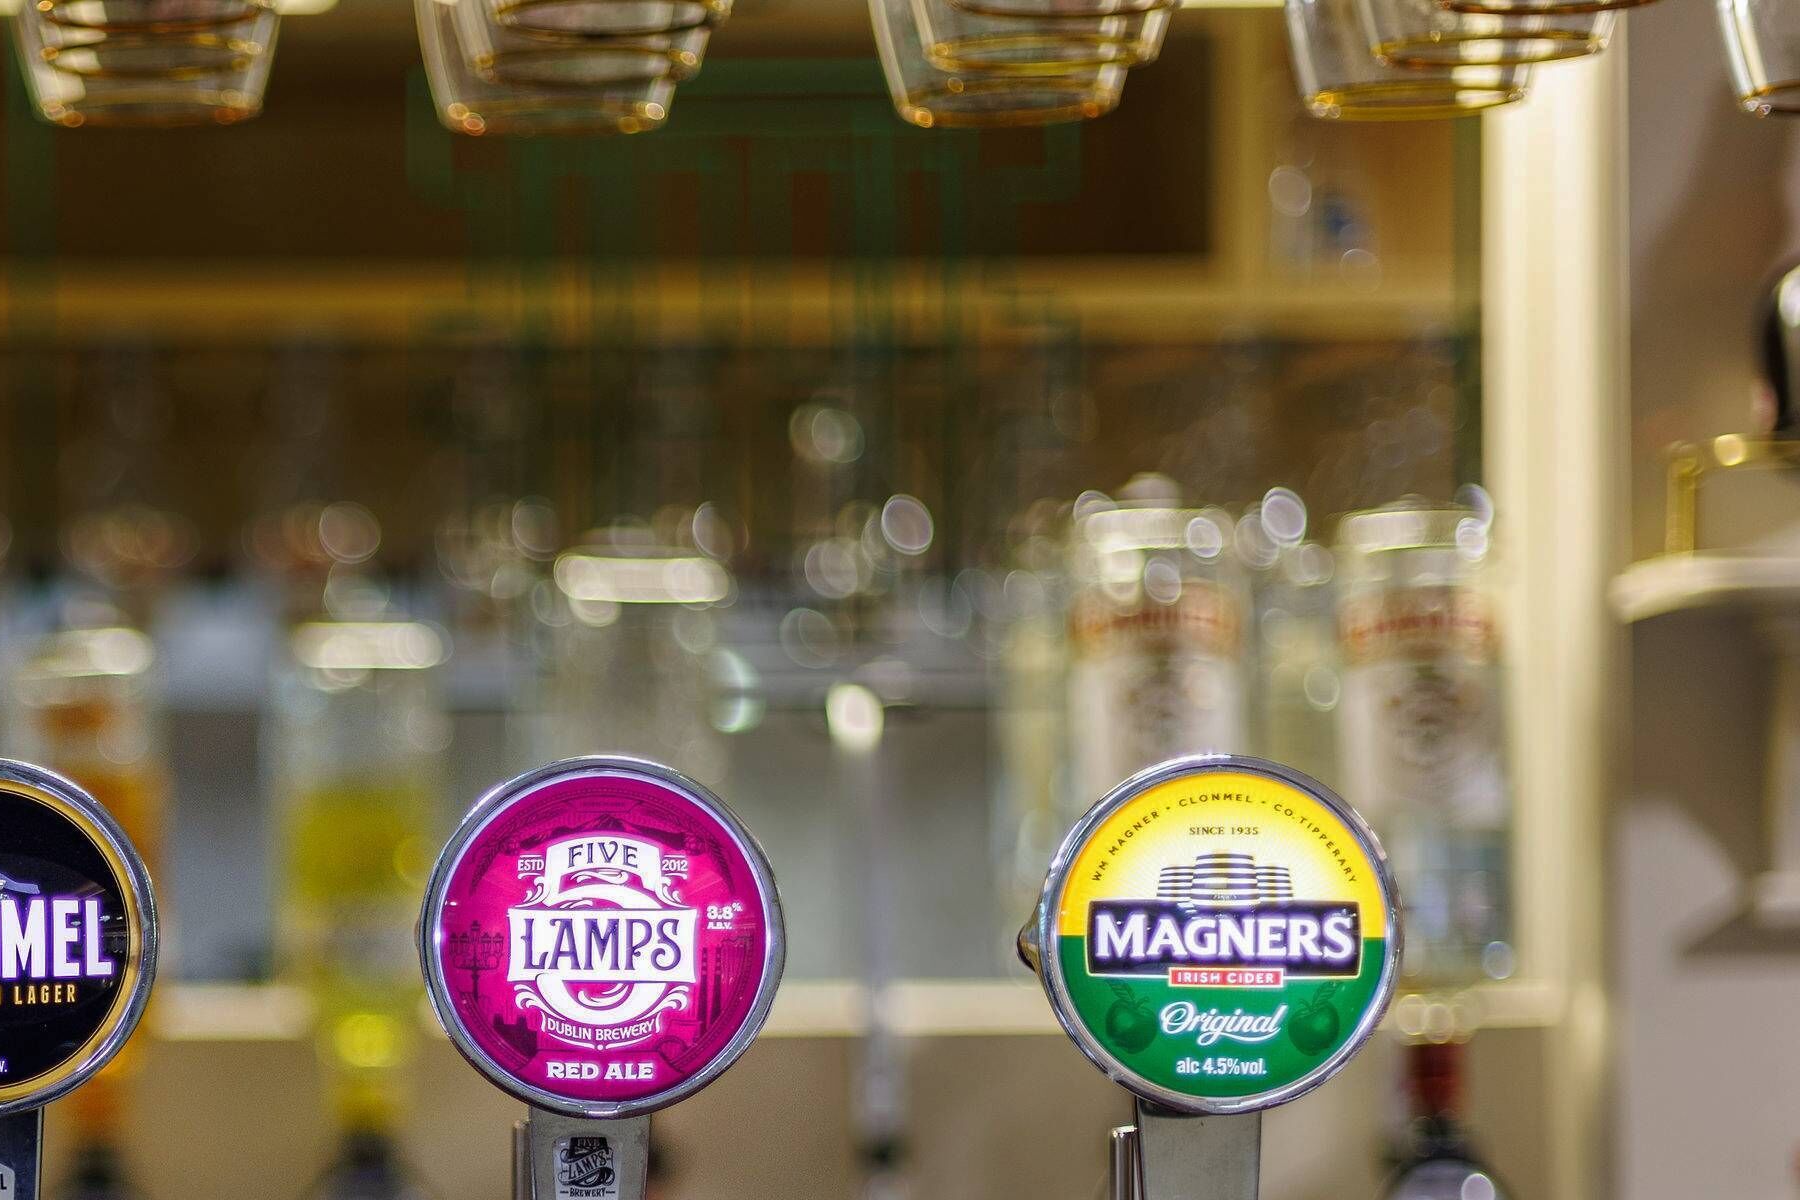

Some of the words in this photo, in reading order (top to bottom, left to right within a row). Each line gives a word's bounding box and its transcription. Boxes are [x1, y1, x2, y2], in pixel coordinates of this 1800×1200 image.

[1092, 861, 1108, 881] WM
[1108, 811, 1159, 855] MAGNER
[1179, 793, 1252, 807] CLONMEL
[1189, 826, 1224, 836] SINCE
[1231, 826, 1259, 836] 1935
[517, 859, 545, 871] ESTD
[567, 840, 638, 868] FIVE
[661, 859, 688, 871] 2012
[520, 917, 682, 971] LAMPS
[1094, 912, 1357, 960] MAGNERS
[1177, 972, 1221, 983] IRISH
[1226, 972, 1275, 983] CIDER
[14, 983, 75, 1005] LAGER
[547, 1017, 591, 1040] DUBLIN
[595, 1018, 655, 1041] BREWERY
[1160, 1001, 1288, 1045] Original
[545, 1061, 599, 1079] RED
[603, 1062, 654, 1080] ALE
[1176, 1057, 1200, 1074] alc
[569, 1150, 607, 1180] LAMPS
[569, 1187, 606, 1198] BREWERY
